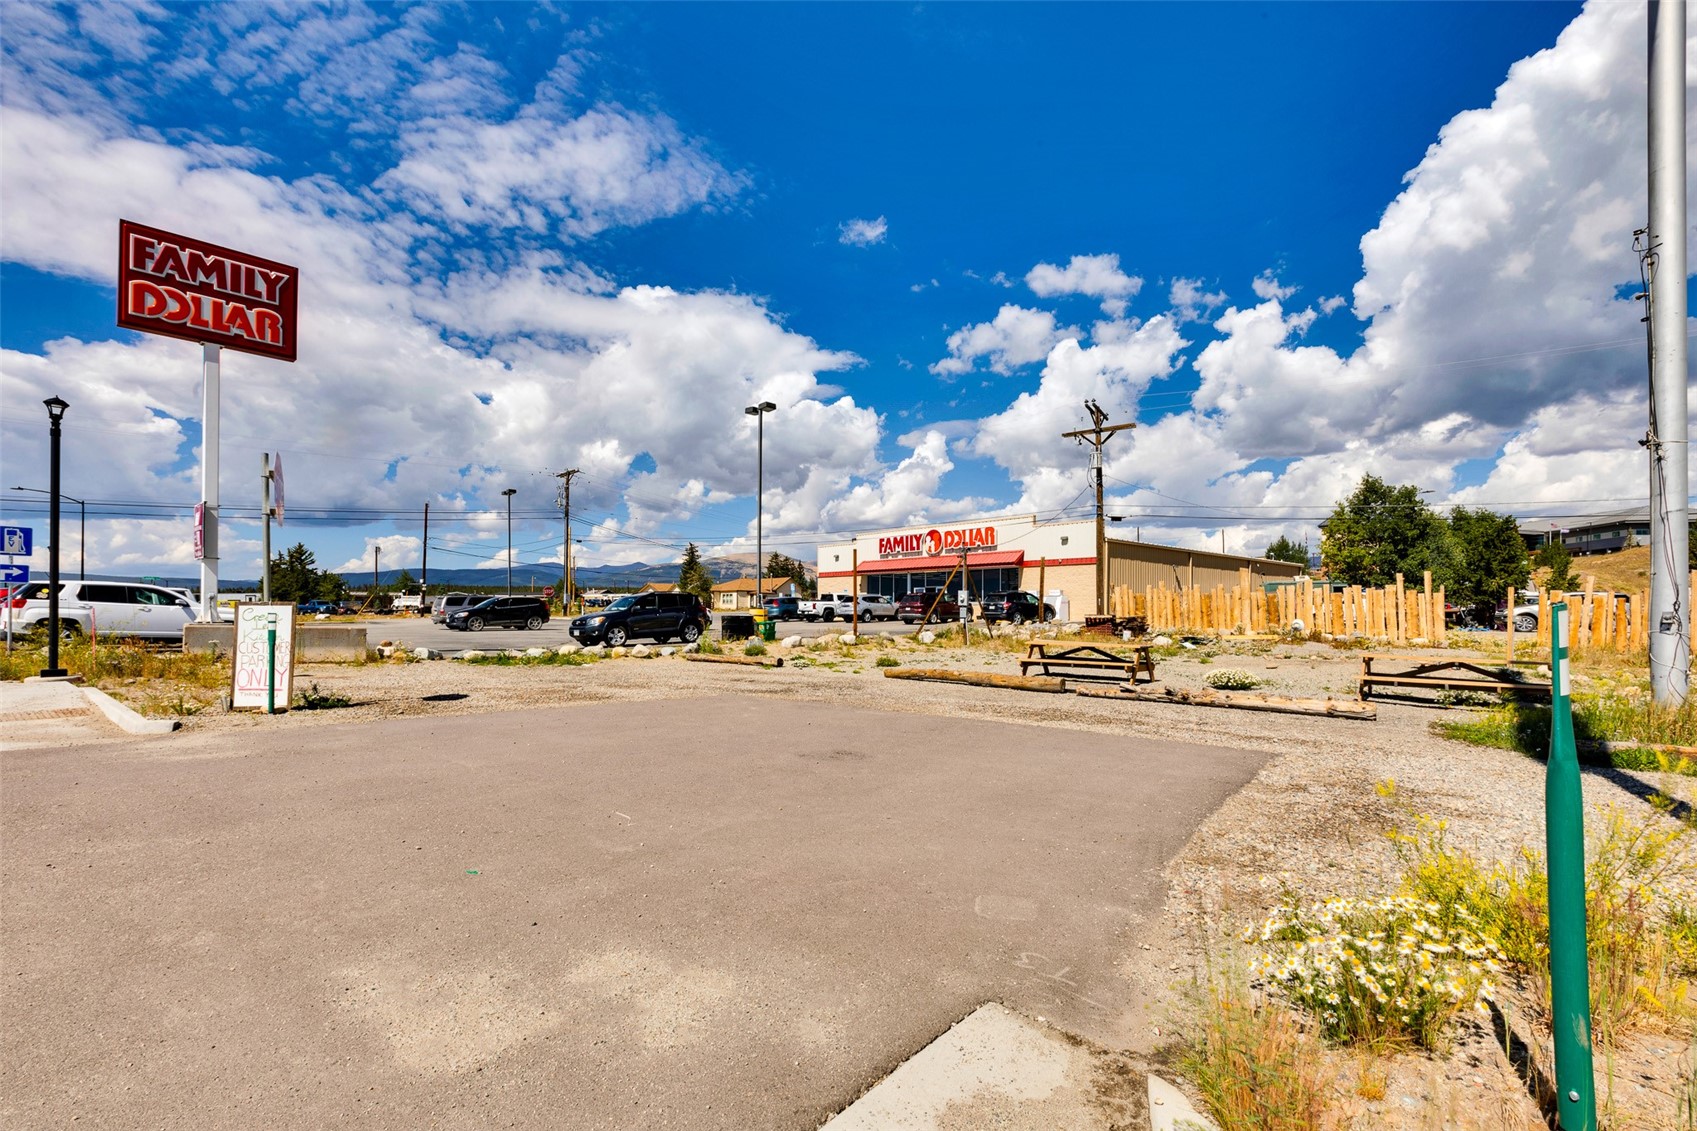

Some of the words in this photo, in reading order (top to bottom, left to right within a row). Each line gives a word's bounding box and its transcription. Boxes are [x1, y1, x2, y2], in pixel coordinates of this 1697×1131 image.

[129, 233, 290, 305] FAMILY
[128, 279, 283, 346] DOLLAR
[879, 533, 923, 554] FAMILY
[943, 526, 996, 549] DOLLAR
[236, 668, 288, 688] ONLY
